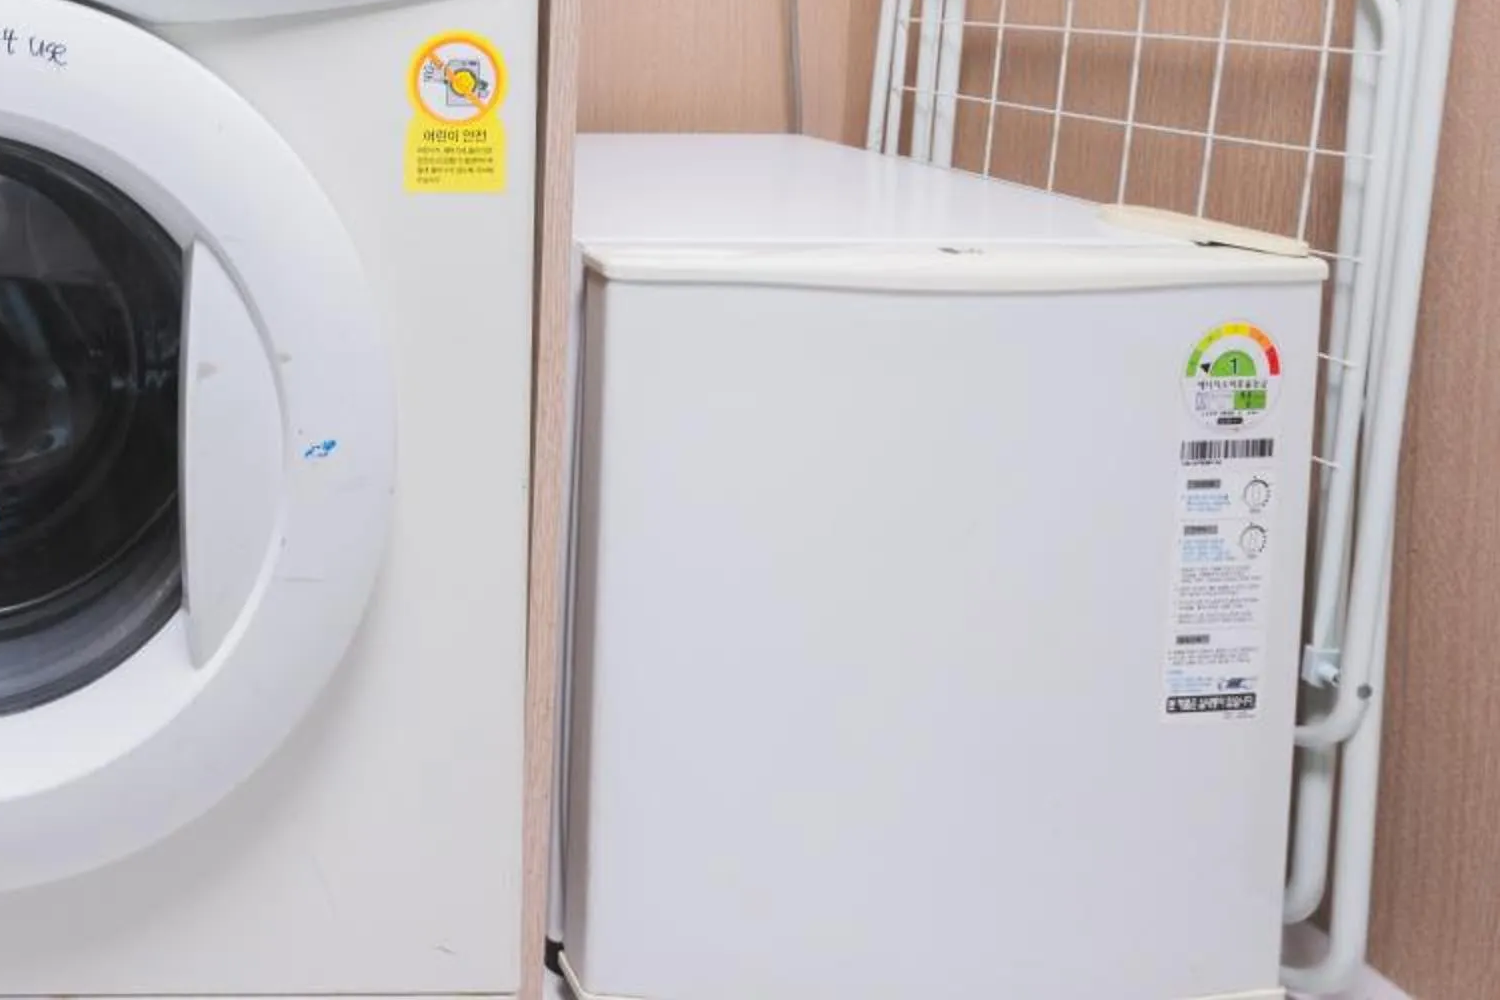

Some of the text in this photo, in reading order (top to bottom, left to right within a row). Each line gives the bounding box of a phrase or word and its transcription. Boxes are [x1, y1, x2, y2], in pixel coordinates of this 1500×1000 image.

[29, 36, 68, 66] use
[423, 128, 459, 142] 어린이
[1229, 358, 1237, 375] 1
